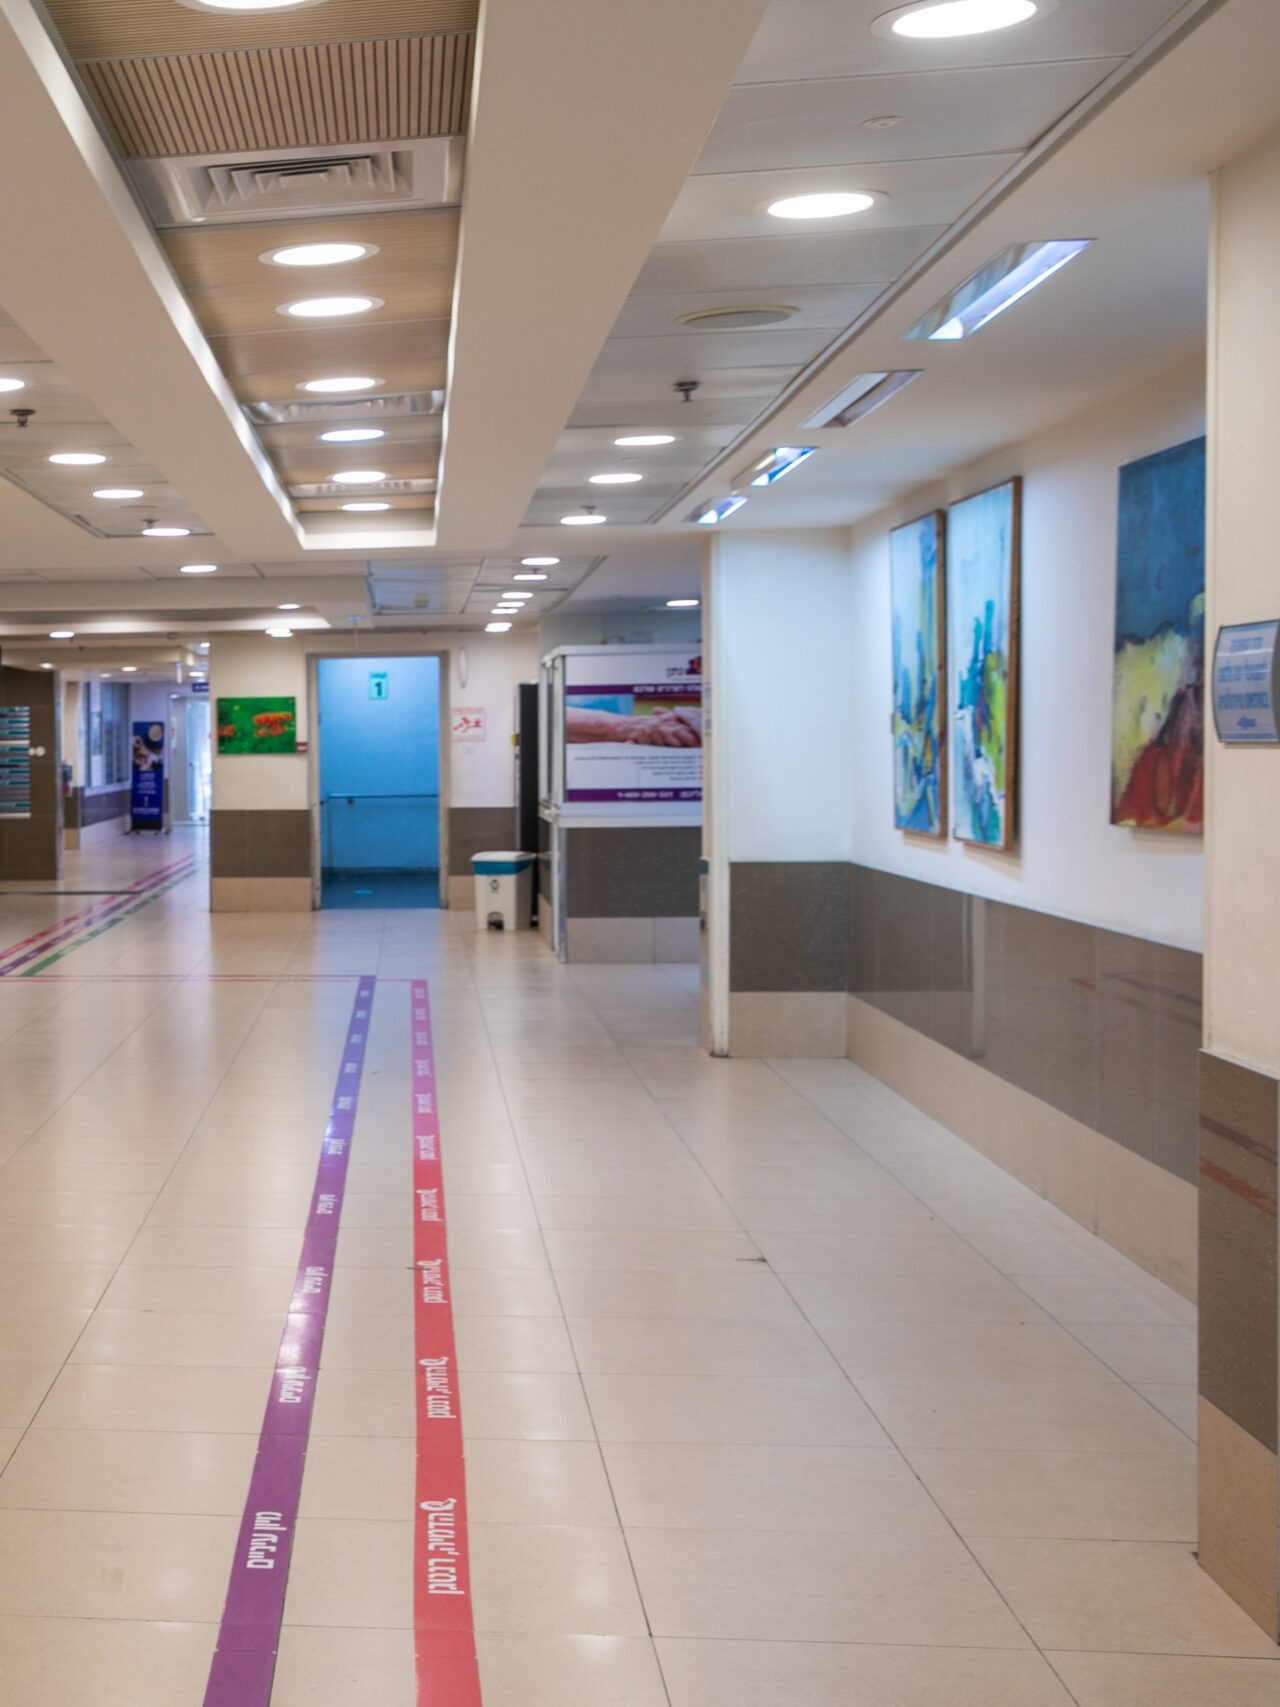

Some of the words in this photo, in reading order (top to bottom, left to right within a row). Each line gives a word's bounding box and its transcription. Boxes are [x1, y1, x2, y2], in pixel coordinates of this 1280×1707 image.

[374, 681, 383, 697] 1
[426, 1395, 458, 1419] רנטגן
[252, 1511, 287, 1531] מיון
[428, 1512, 460, 1555] הדמיה,
[246, 1533, 279, 1570] עיניים
[427, 1557, 465, 1595] רנטגן
